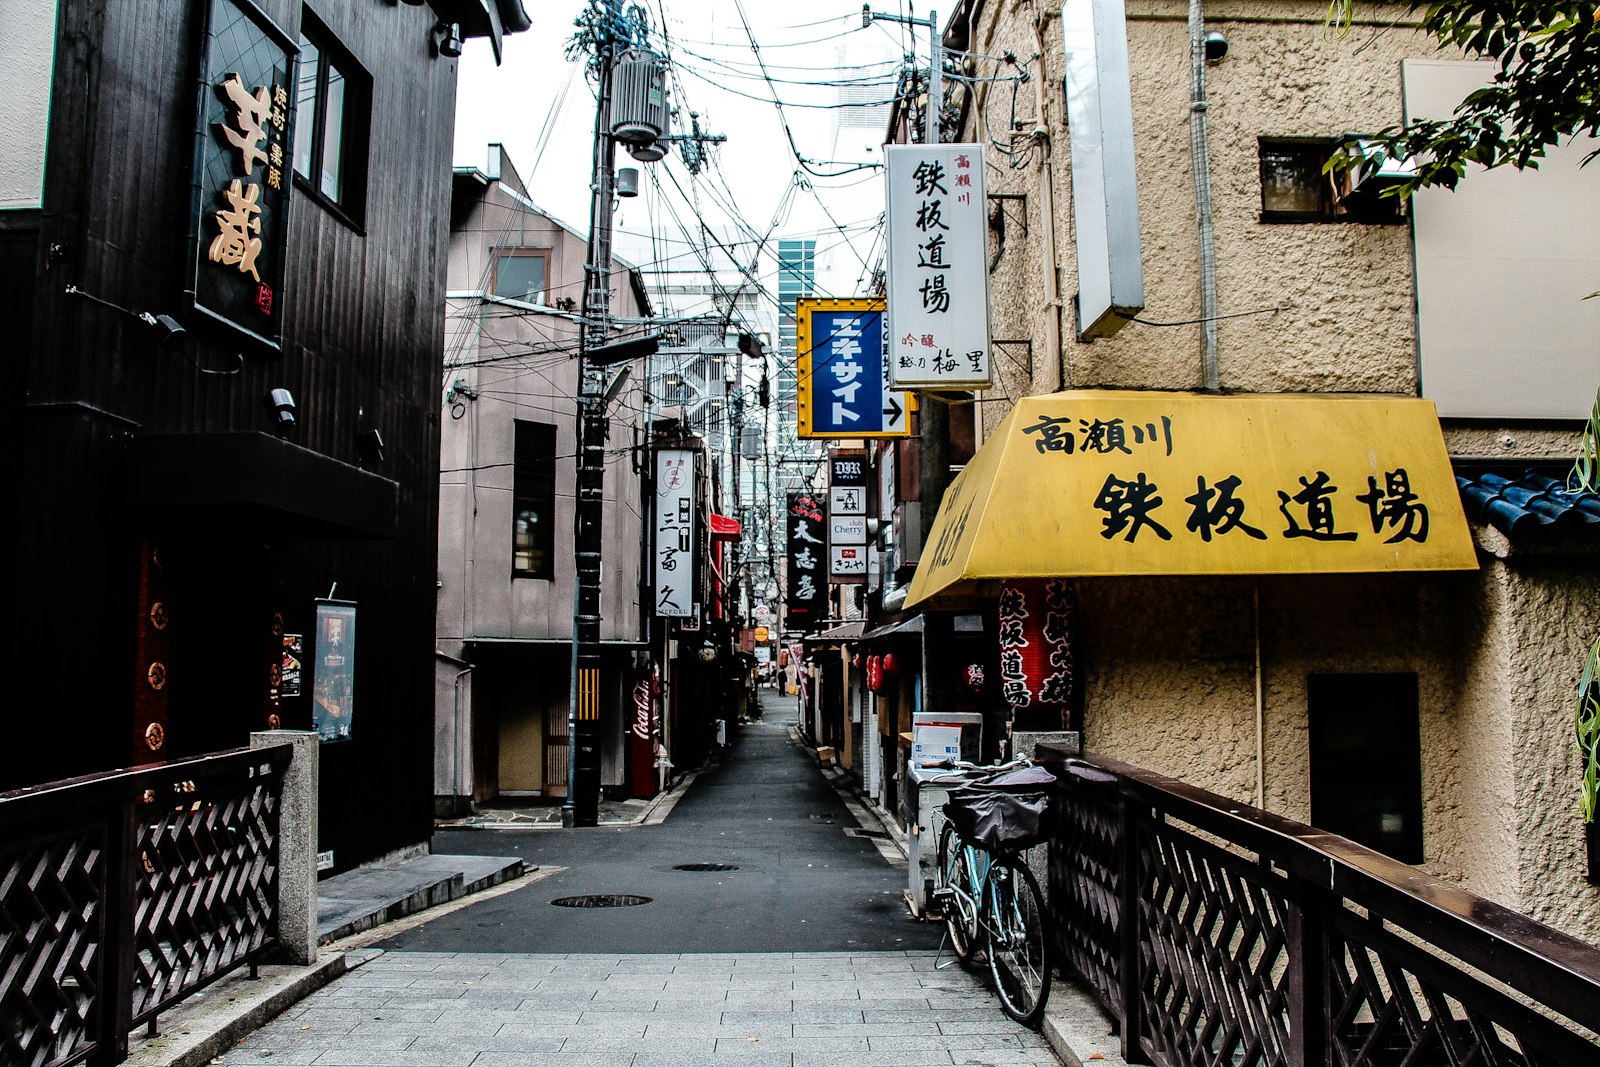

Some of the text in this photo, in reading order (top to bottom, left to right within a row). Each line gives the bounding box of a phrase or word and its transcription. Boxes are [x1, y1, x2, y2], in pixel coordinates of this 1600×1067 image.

[954, 154, 972, 206] 高瀬川
[912, 160, 951, 314] 鉄板道場
[830, 318, 863, 425] エキサイト
[1021, 415, 1173, 456] 高瀬川
[834, 524, 863, 536] Cherry
[849, 519, 864, 527] club
[1093, 468, 1431, 544] 鉄板道場
